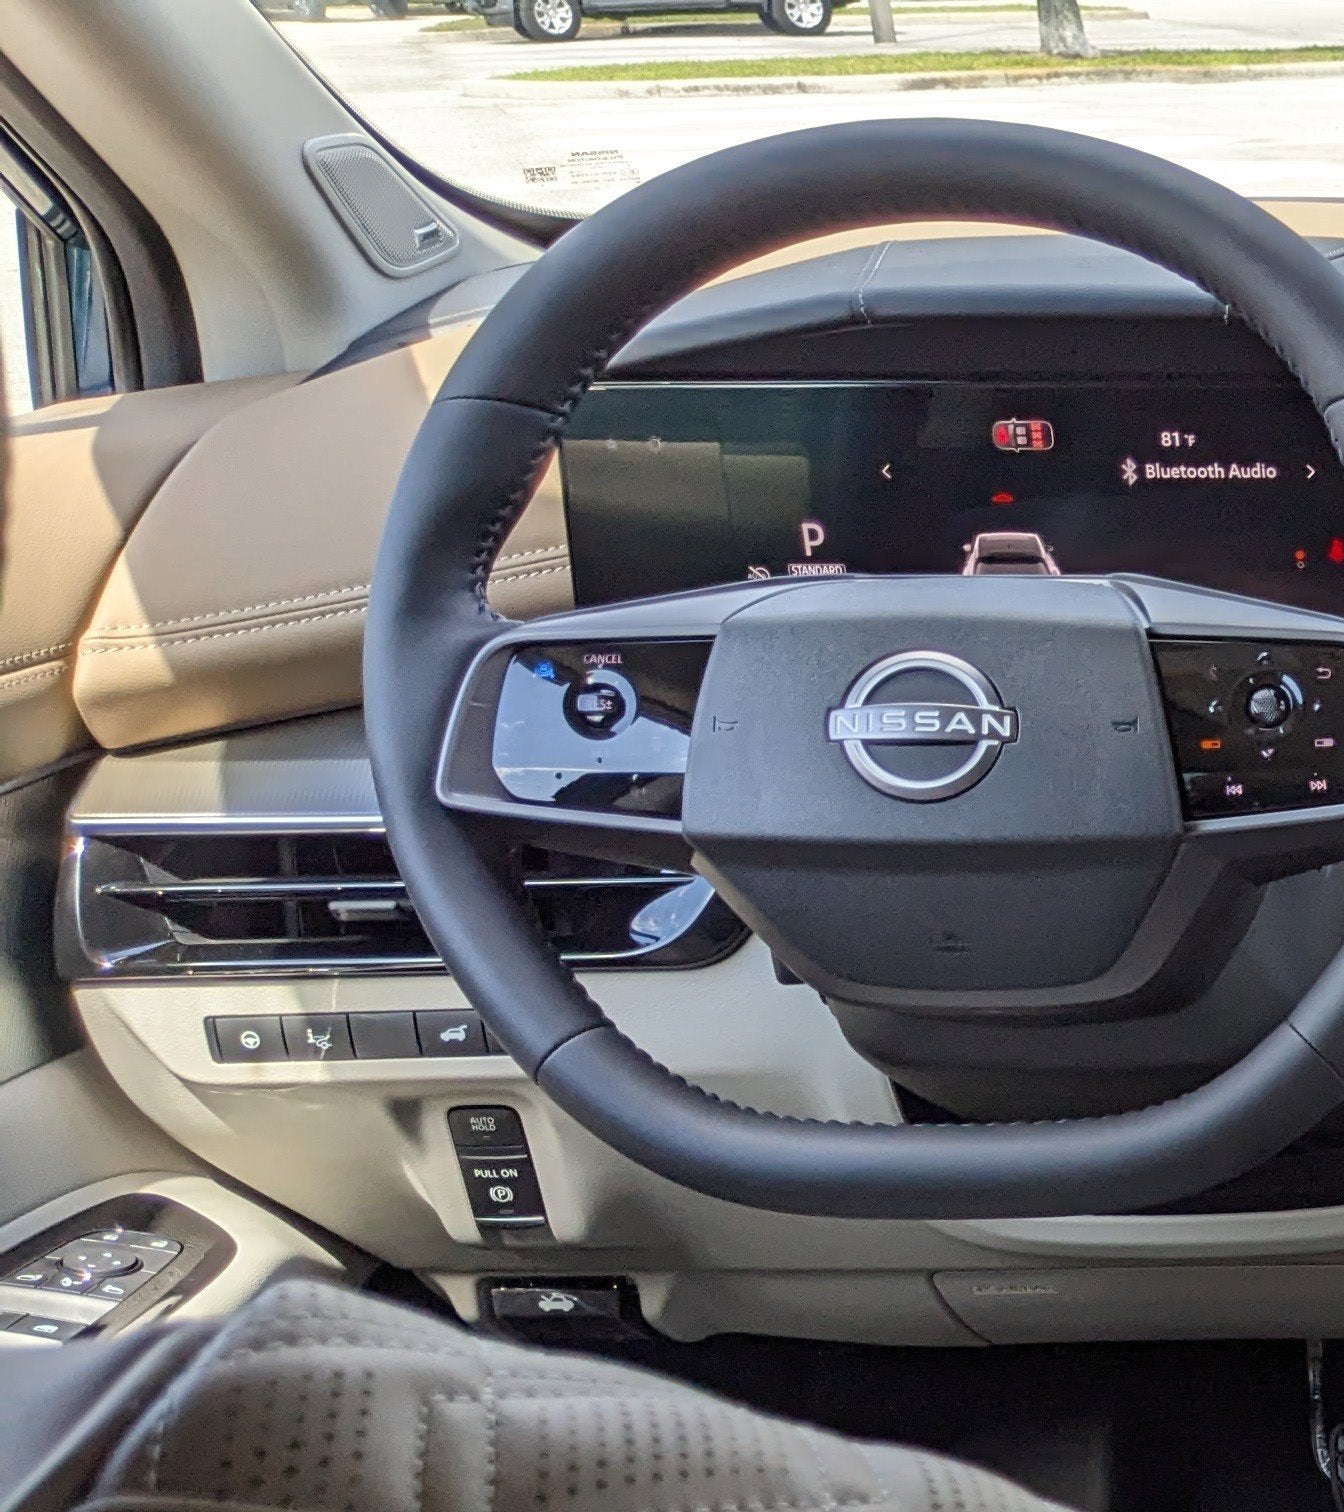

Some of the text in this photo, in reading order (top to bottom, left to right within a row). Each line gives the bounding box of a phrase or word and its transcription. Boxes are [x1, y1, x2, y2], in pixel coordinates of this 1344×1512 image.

[1145, 463, 1277, 479] Bluetooth Audio
[801, 523, 825, 557] P
[791, 565, 843, 576] STANDARD
[583, 654, 623, 664] CANCEL
[835, 710, 1011, 737] NISSAN
[474, 1168, 518, 1178] PULL ON
